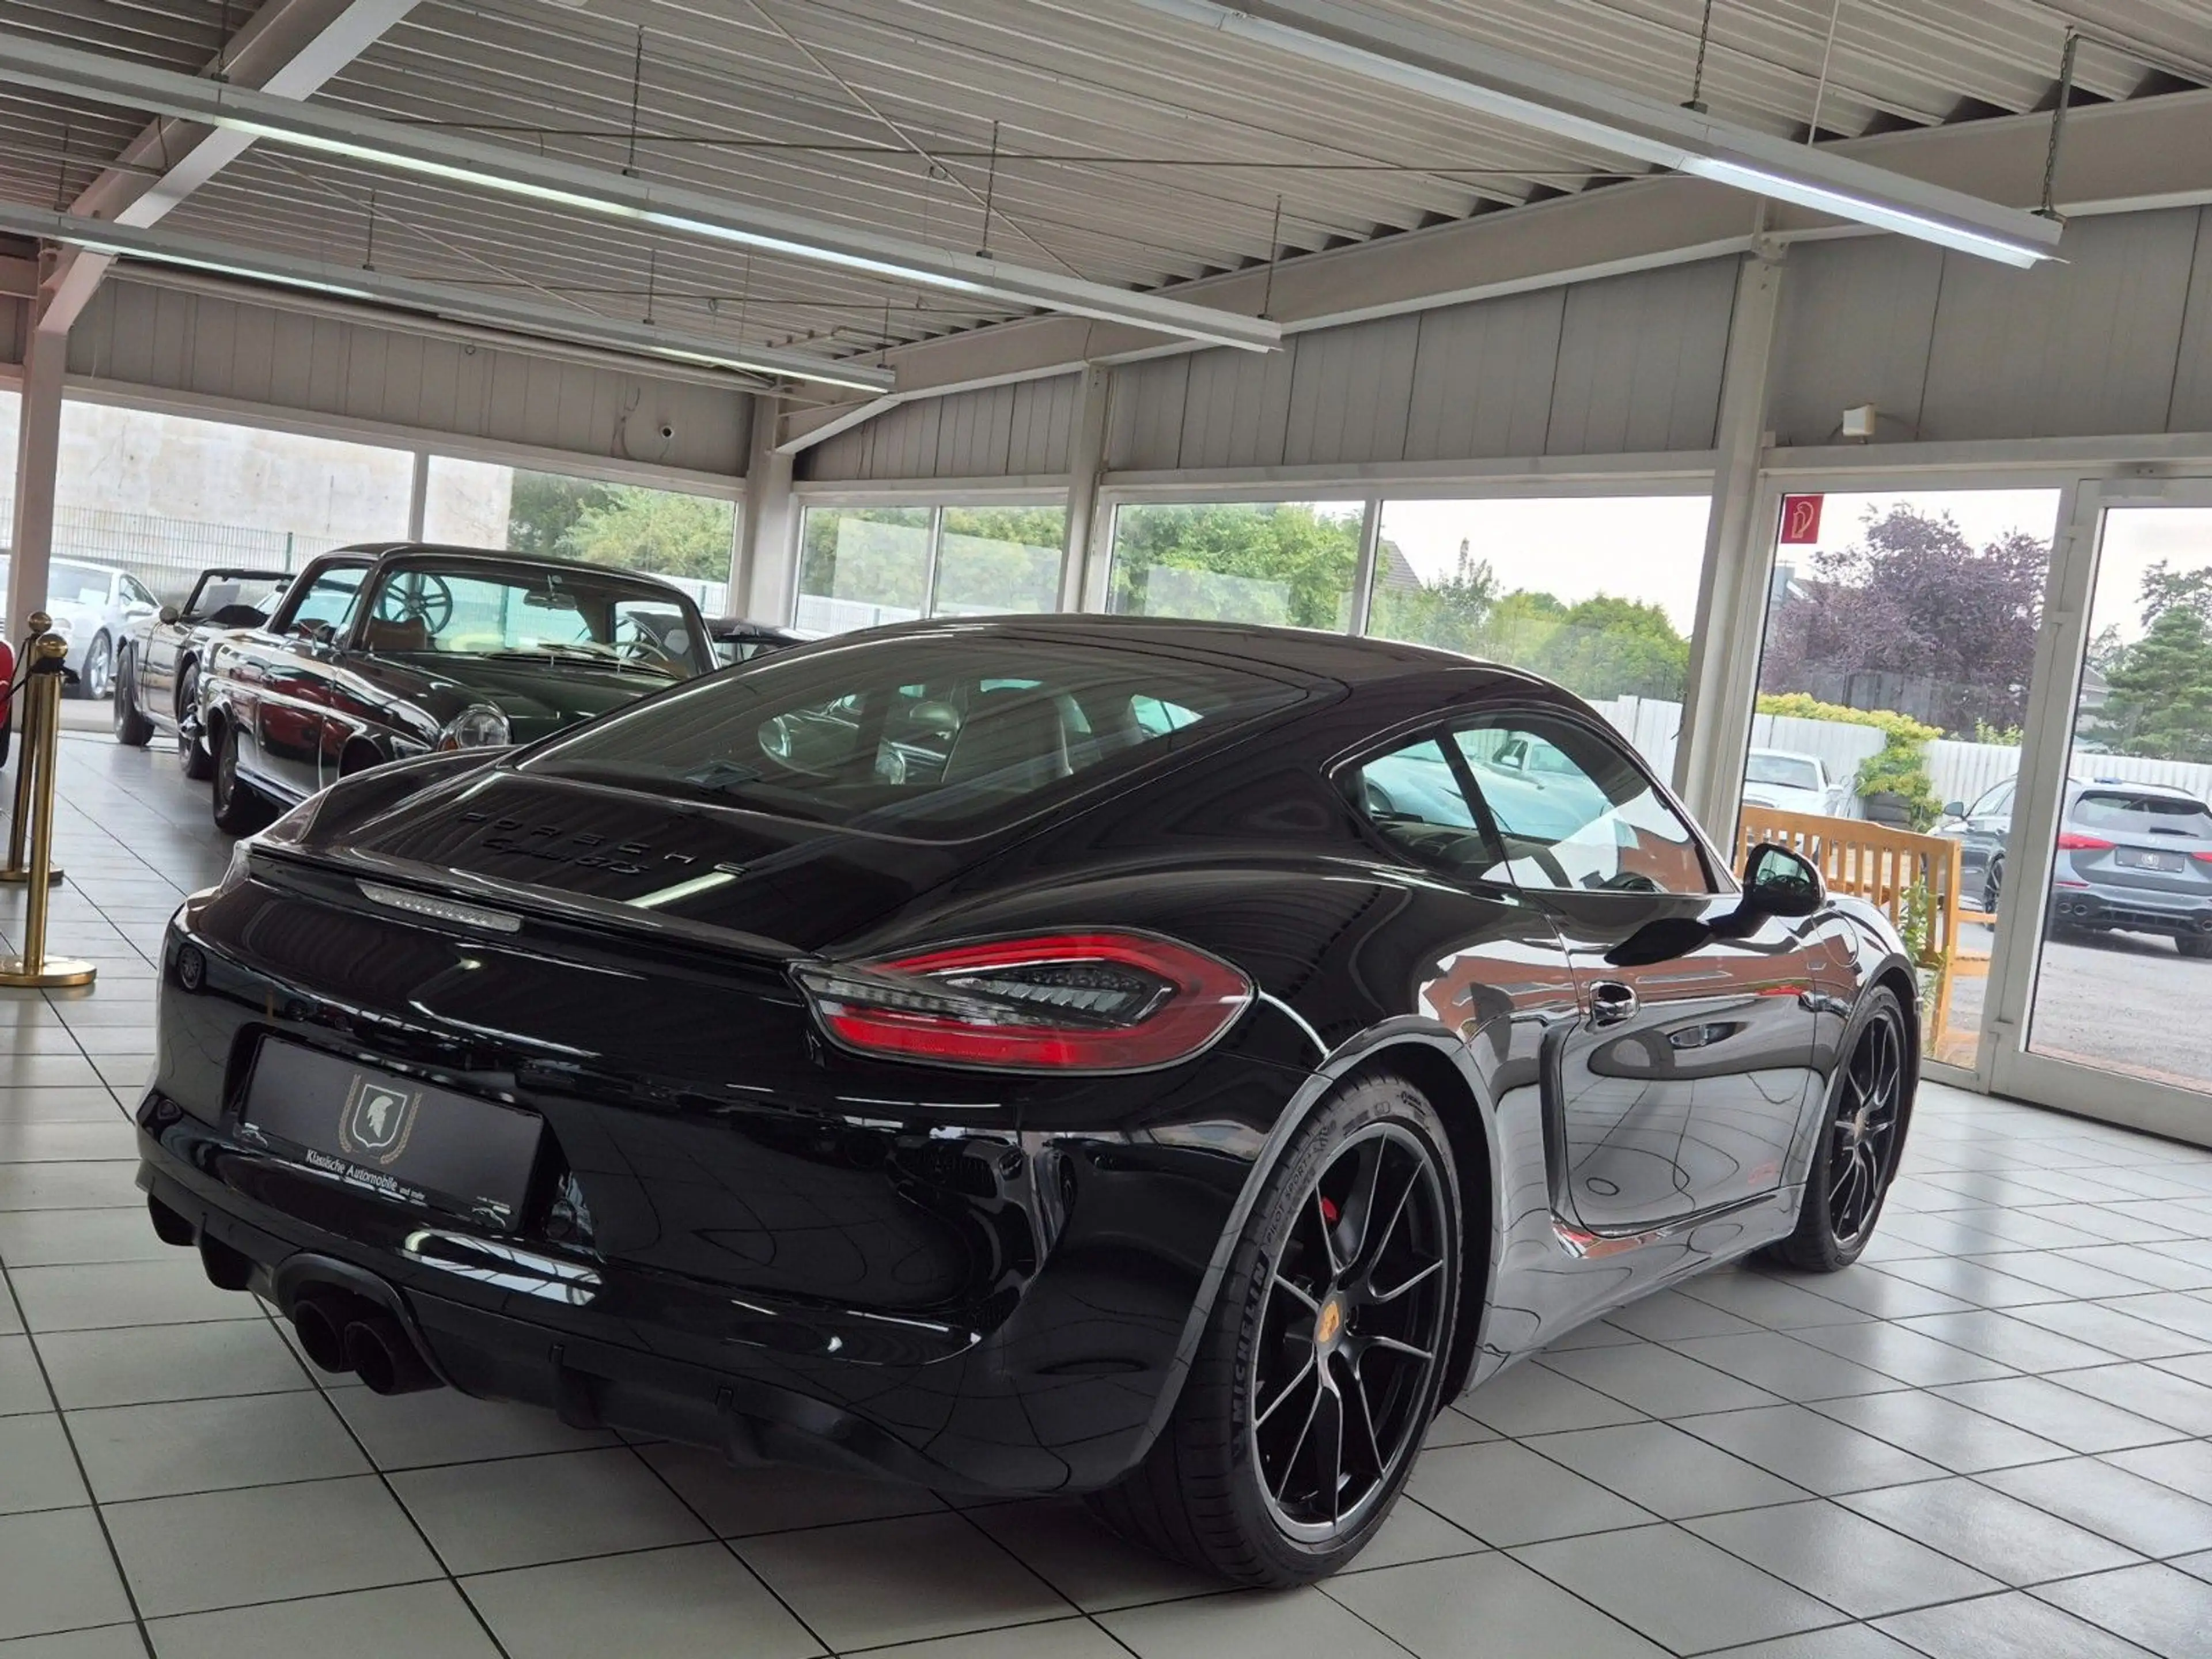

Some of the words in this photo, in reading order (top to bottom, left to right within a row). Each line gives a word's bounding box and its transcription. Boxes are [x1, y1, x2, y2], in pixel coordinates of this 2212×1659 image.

[462, 811, 750, 875] PORSCHE
[305, 1149, 346, 1175] Klassische
[346, 1164, 398, 1192] Automobile
[1266, 1203, 1285, 1244] PILOT
[1285, 1159, 1308, 1199] SPORT
[1232, 1262, 1266, 1423] MICHELIN
